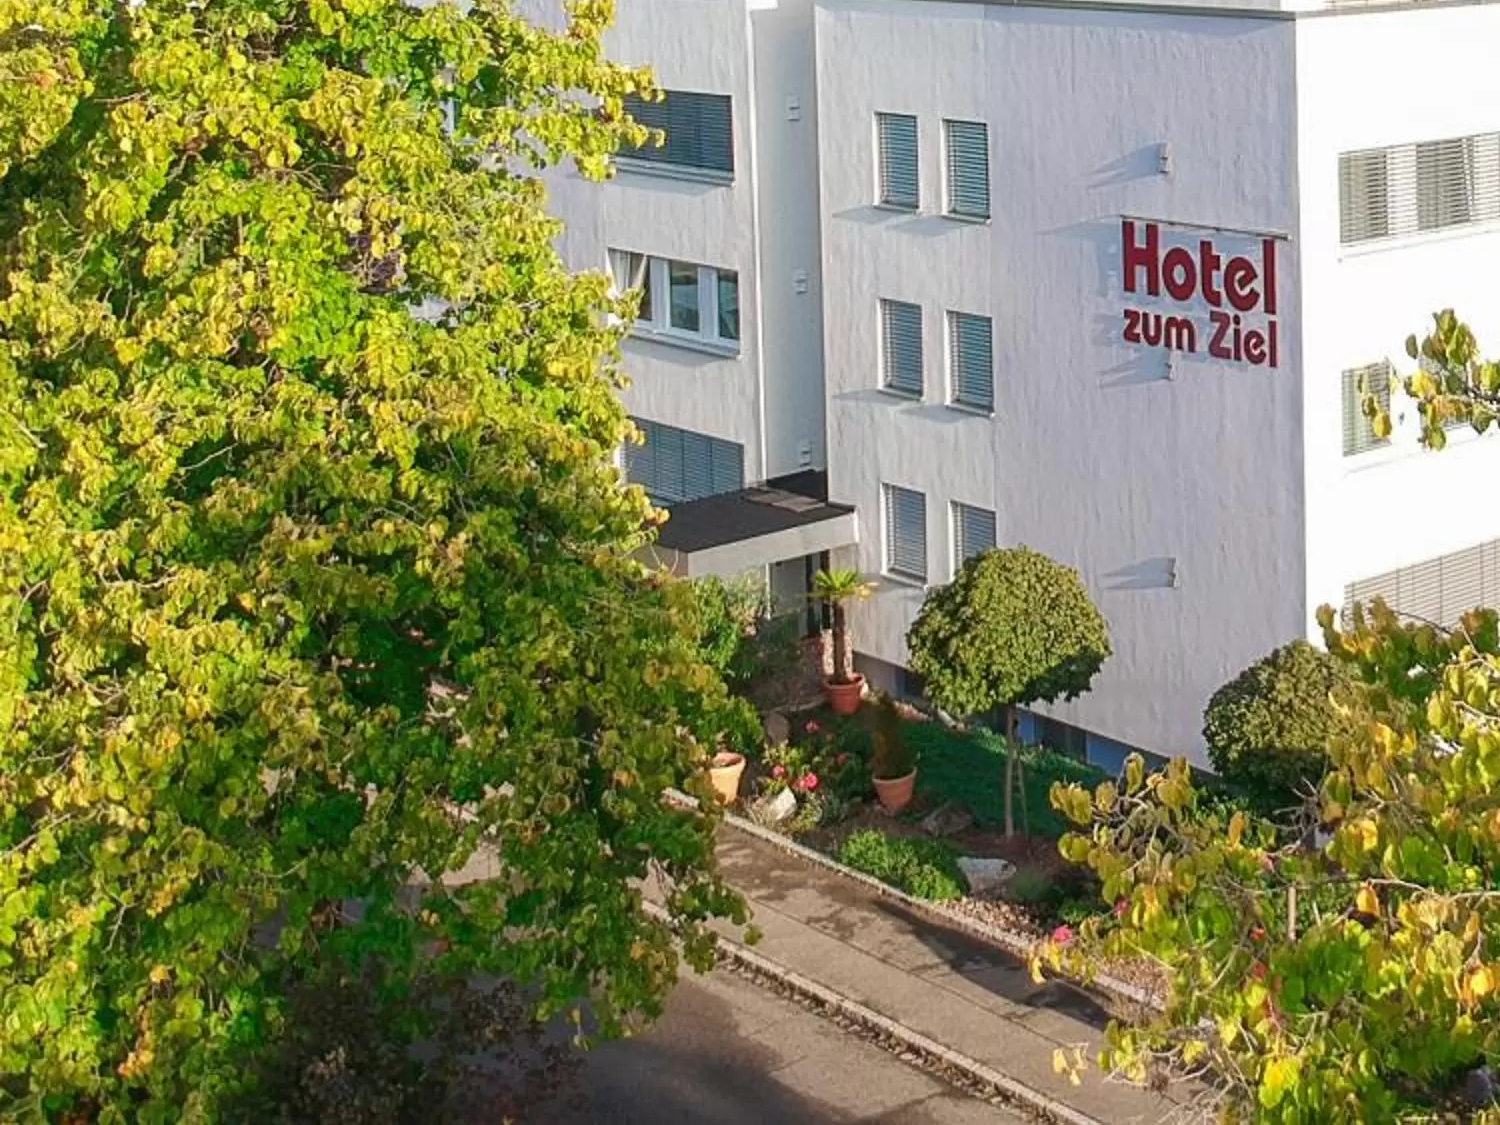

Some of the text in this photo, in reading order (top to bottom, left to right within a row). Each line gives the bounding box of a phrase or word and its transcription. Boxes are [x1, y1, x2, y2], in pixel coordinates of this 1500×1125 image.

[1121, 220, 1277, 315] Hotel
[1123, 308, 1278, 368] zum Ziel
